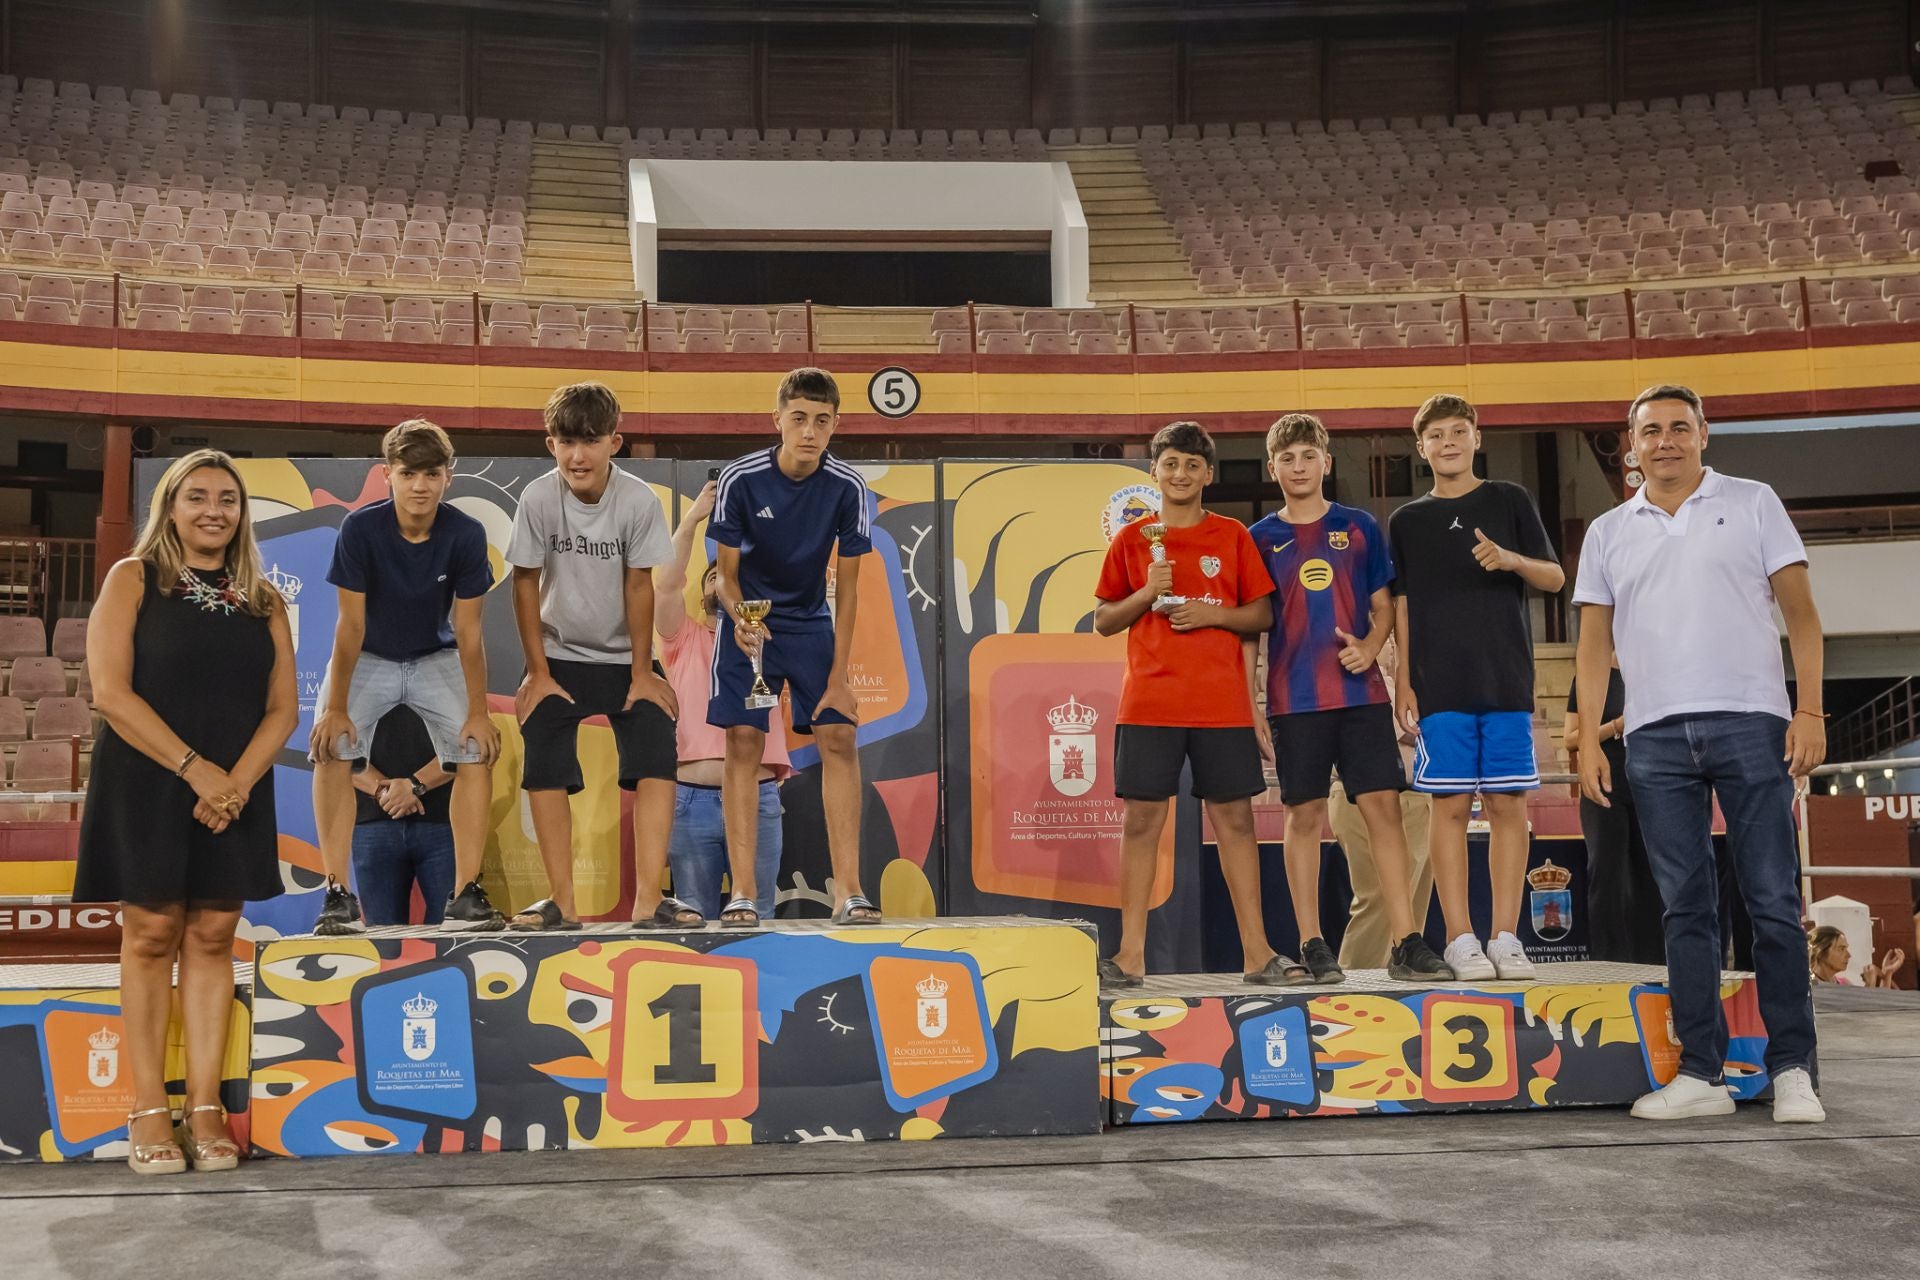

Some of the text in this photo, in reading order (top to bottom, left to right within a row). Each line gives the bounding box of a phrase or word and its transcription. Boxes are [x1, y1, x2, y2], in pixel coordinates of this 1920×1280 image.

[884, 377, 906, 409] 5
[549, 533, 573, 554] Los
[1033, 799, 1115, 809] AYUNTAMIENTO DE
[1013, 810, 1079, 826] ROQUETAS
[1084, 811, 1100, 824] DE
[1524, 945, 1577, 953] AYUNTAMIENTO
[647, 983, 716, 1084] 1
[894, 1047, 936, 1057] ROQUETAS
[1443, 1014, 1493, 1082] 3
[377, 1069, 461, 1080] ROQUETAS DE MAR
